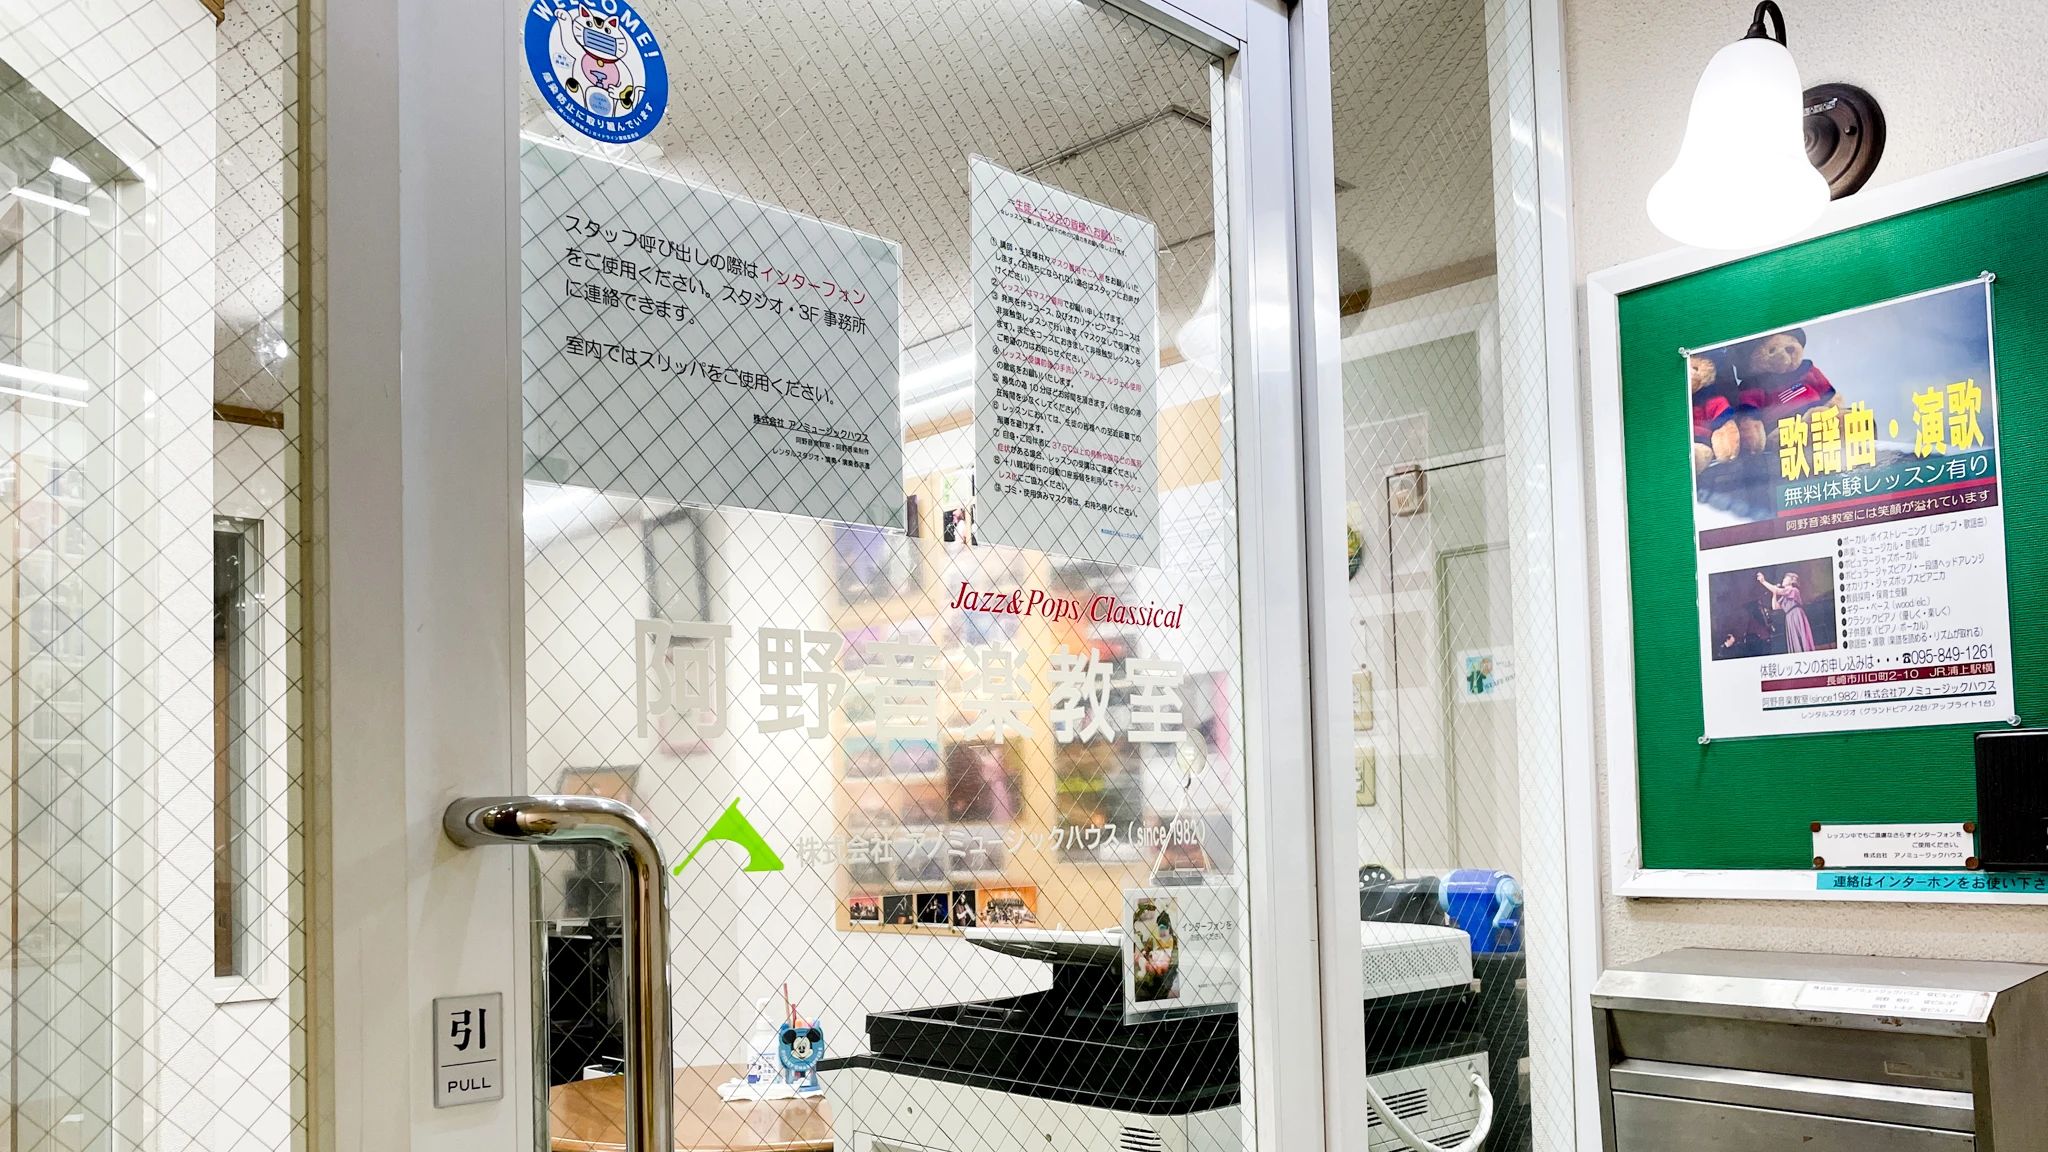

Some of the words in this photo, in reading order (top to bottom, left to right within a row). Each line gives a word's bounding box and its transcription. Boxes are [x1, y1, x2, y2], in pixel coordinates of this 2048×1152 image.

[542, 72, 653, 131] 感染防止に取り組んでいます
[565, 214, 866, 305] スタッフ呼び出しの際はインターフォン
[565, 280, 698, 325] に連絡できます。
[565, 335, 835, 405] 室内ではスリッパをご使用ください。
[752, 413, 784, 429] 株式会社
[1777, 378, 1985, 481] 歌謡曲・演歌
[1784, 455, 1988, 506] 無料体験レッスン有り
[1786, 490, 1989, 531] 阿野音楽教室には笑顔が溢れています
[950, 581, 1184, 629] Jazz&Pops/Classical
[1848, 620, 1928, 637] 子供音楽（ピアノボーカル）
[1911, 645, 1994, 665] 095-849-1261
[634, 617, 1187, 745] 阿野音楽教室
[1826, 669, 1919, 687] 長崎市川口町2-10
[796, 832, 894, 868] 株式会社
[1912, 841, 1959, 849] ご使用ください。
[1833, 875, 2046, 890] 連絡はインターホンをお使い下さ
[451, 1008, 486, 1052] 引
[448, 1077, 491, 1093] PULL
